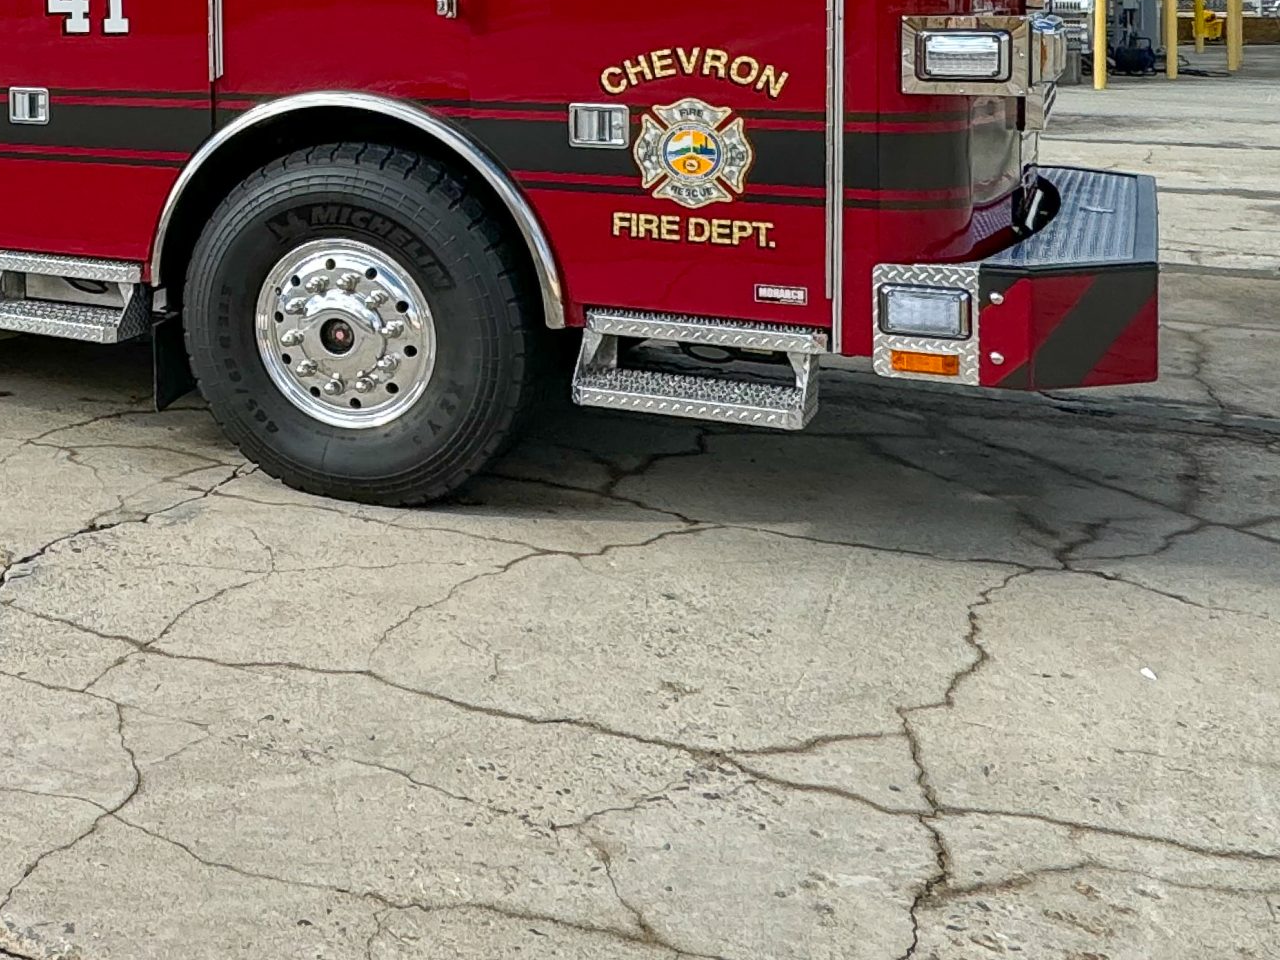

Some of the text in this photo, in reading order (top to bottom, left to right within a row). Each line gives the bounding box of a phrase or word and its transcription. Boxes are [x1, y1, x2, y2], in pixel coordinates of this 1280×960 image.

[600, 47, 789, 98] CHEVRON
[679, 108, 703, 119] FIRE
[670, 185, 713, 197] RESCUE
[310, 204, 452, 288] MICHELIN
[613, 212, 776, 248] FIRE DEPT.
